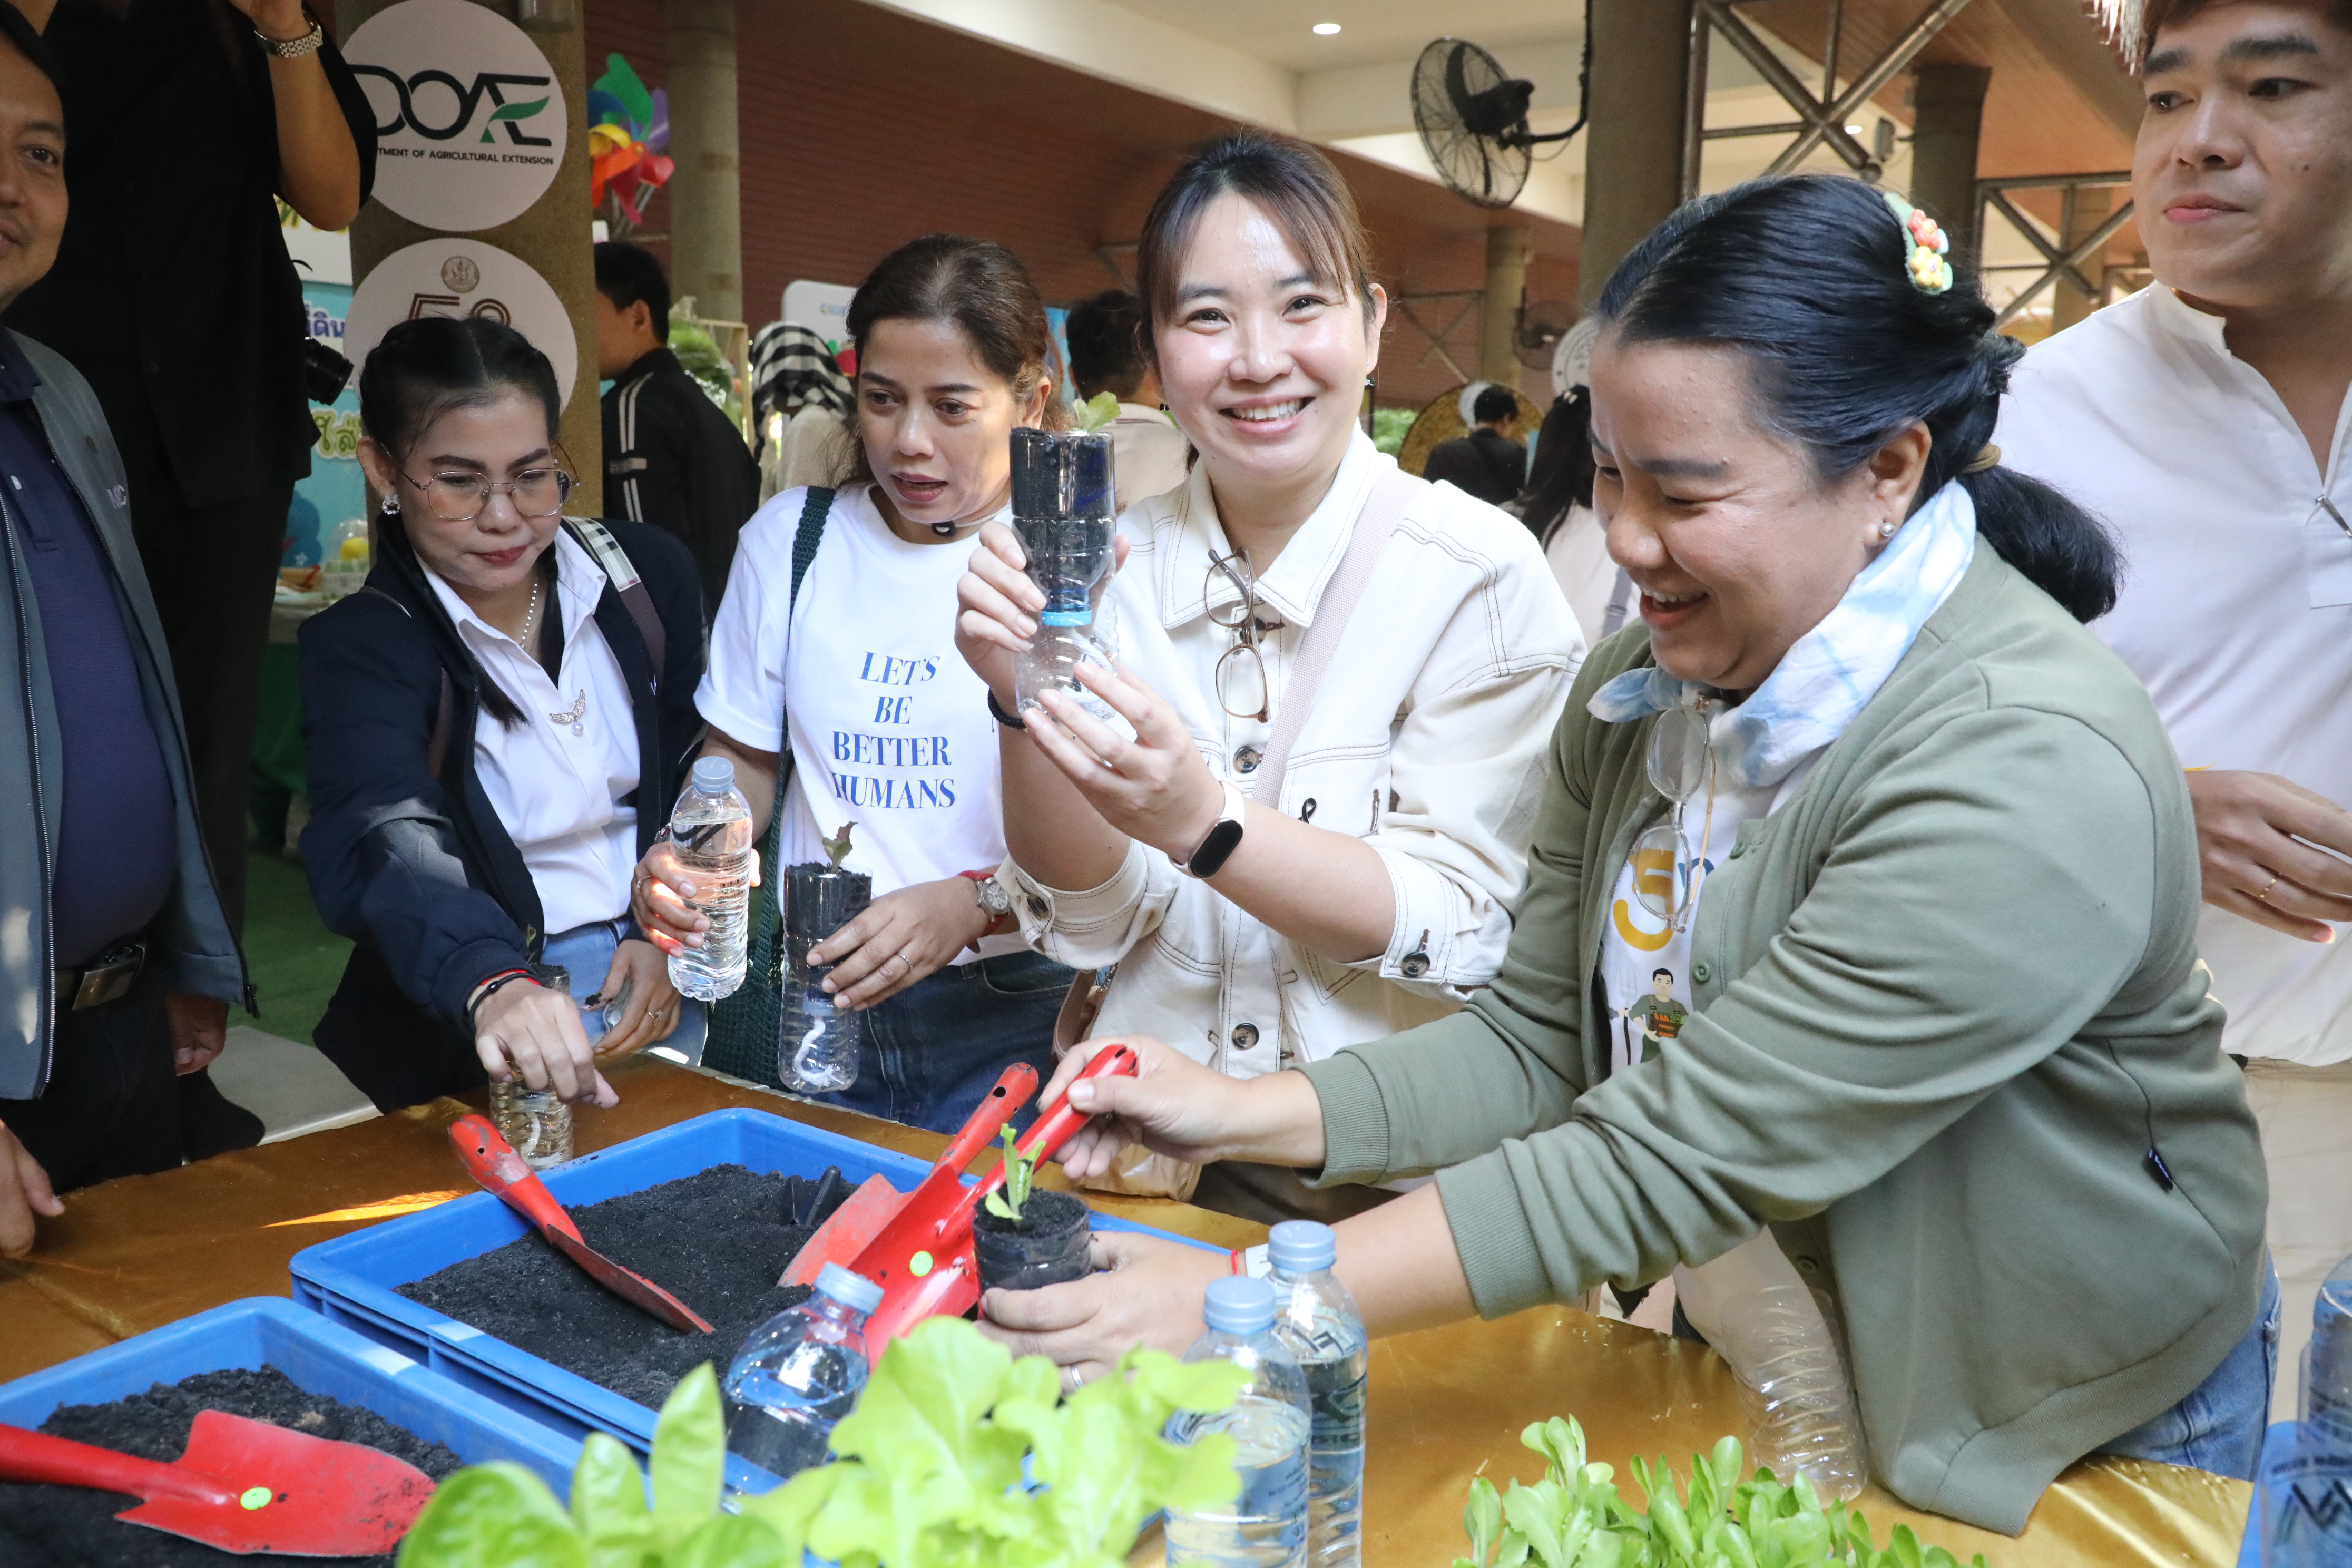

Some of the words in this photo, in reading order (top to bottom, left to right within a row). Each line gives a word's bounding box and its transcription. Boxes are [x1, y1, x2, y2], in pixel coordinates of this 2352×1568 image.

[378, 148, 409, 158] TMENT
[412, 149, 425, 158] OF
[429, 151, 498, 162] AGRICULTURAL
[502, 154, 554, 164] EXTENSION
[858, 651, 941, 685] LET'S
[872, 696, 913, 724] BE
[831, 731, 952, 767] BETTER
[830, 771, 955, 809] HUMANS
